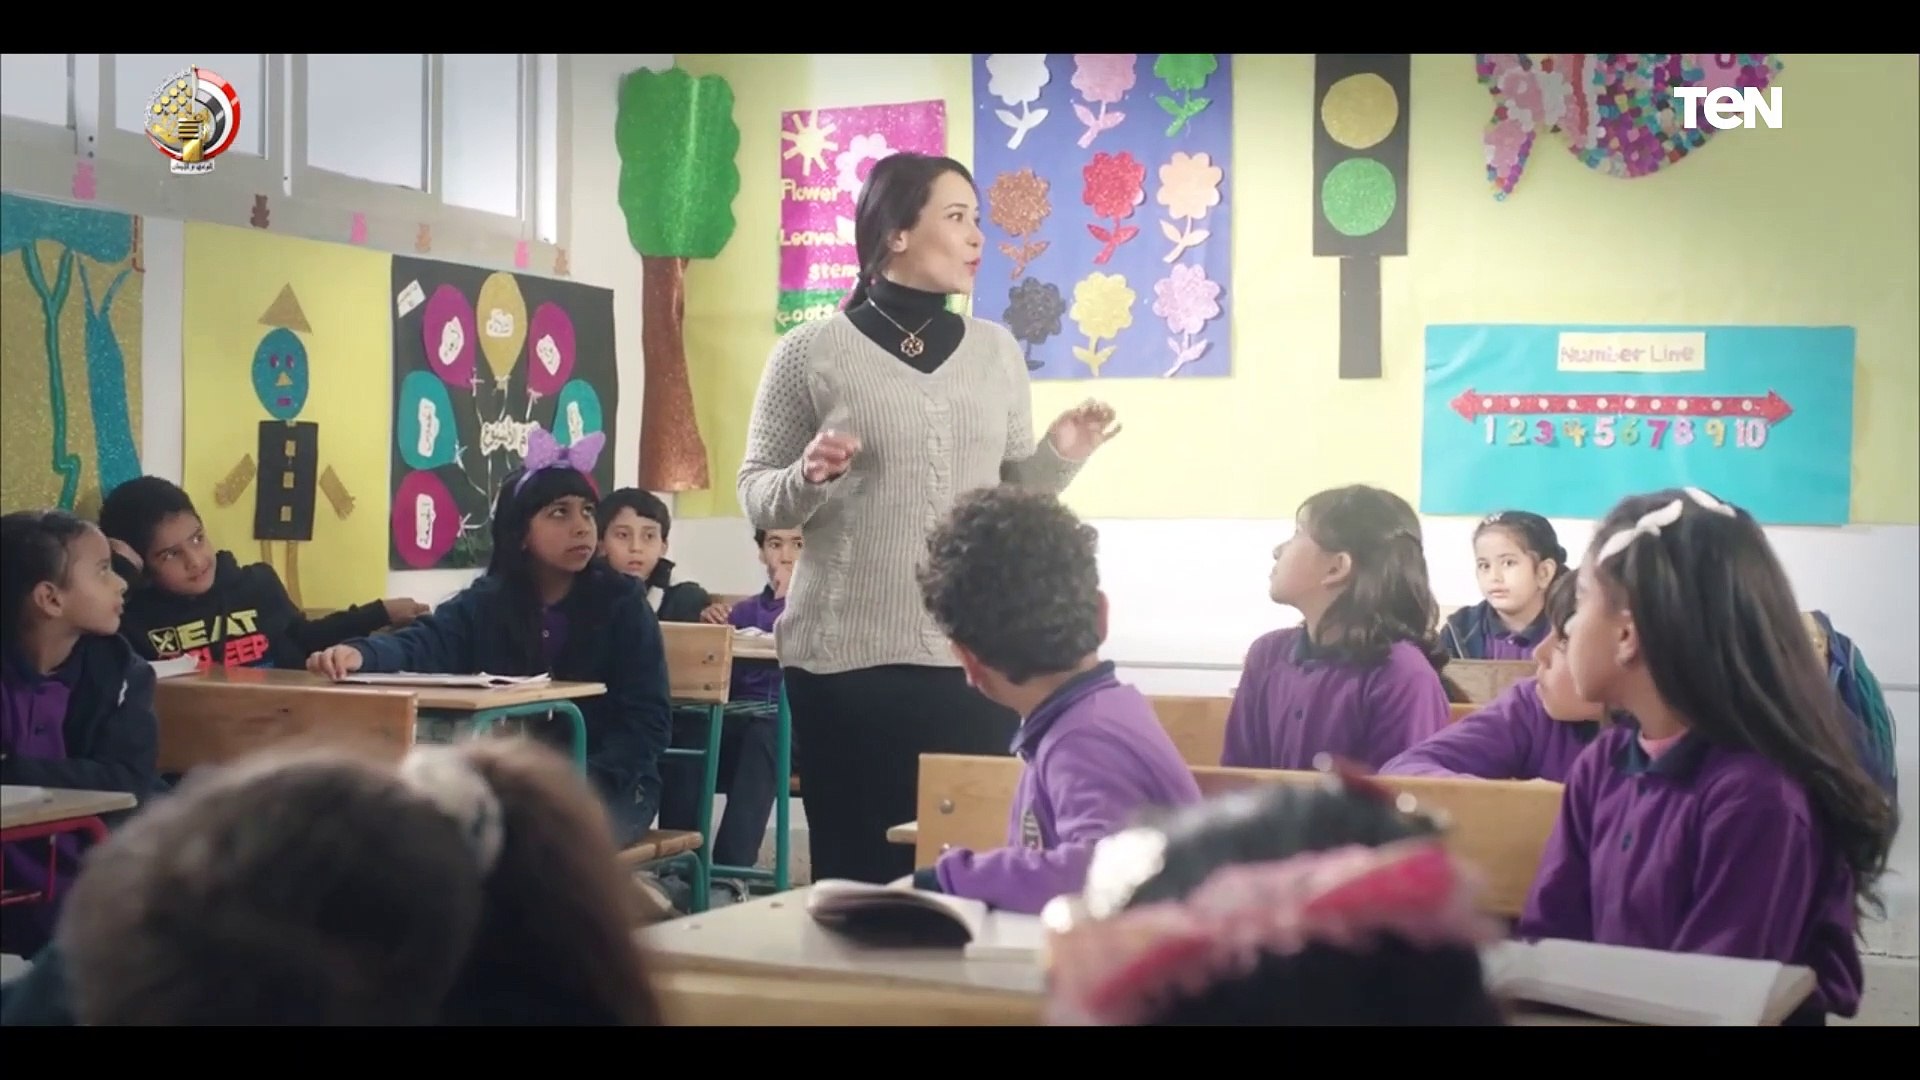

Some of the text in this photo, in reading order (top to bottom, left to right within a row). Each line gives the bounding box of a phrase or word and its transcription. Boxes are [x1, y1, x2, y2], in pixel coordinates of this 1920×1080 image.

[780, 178, 840, 203] Flower
[1560, 344, 1696, 363] Number Line
[1483, 414, 1768, 449] 1 2 3 4 5 6 7 8 9 10
[187, 633, 269, 669] LEEP
